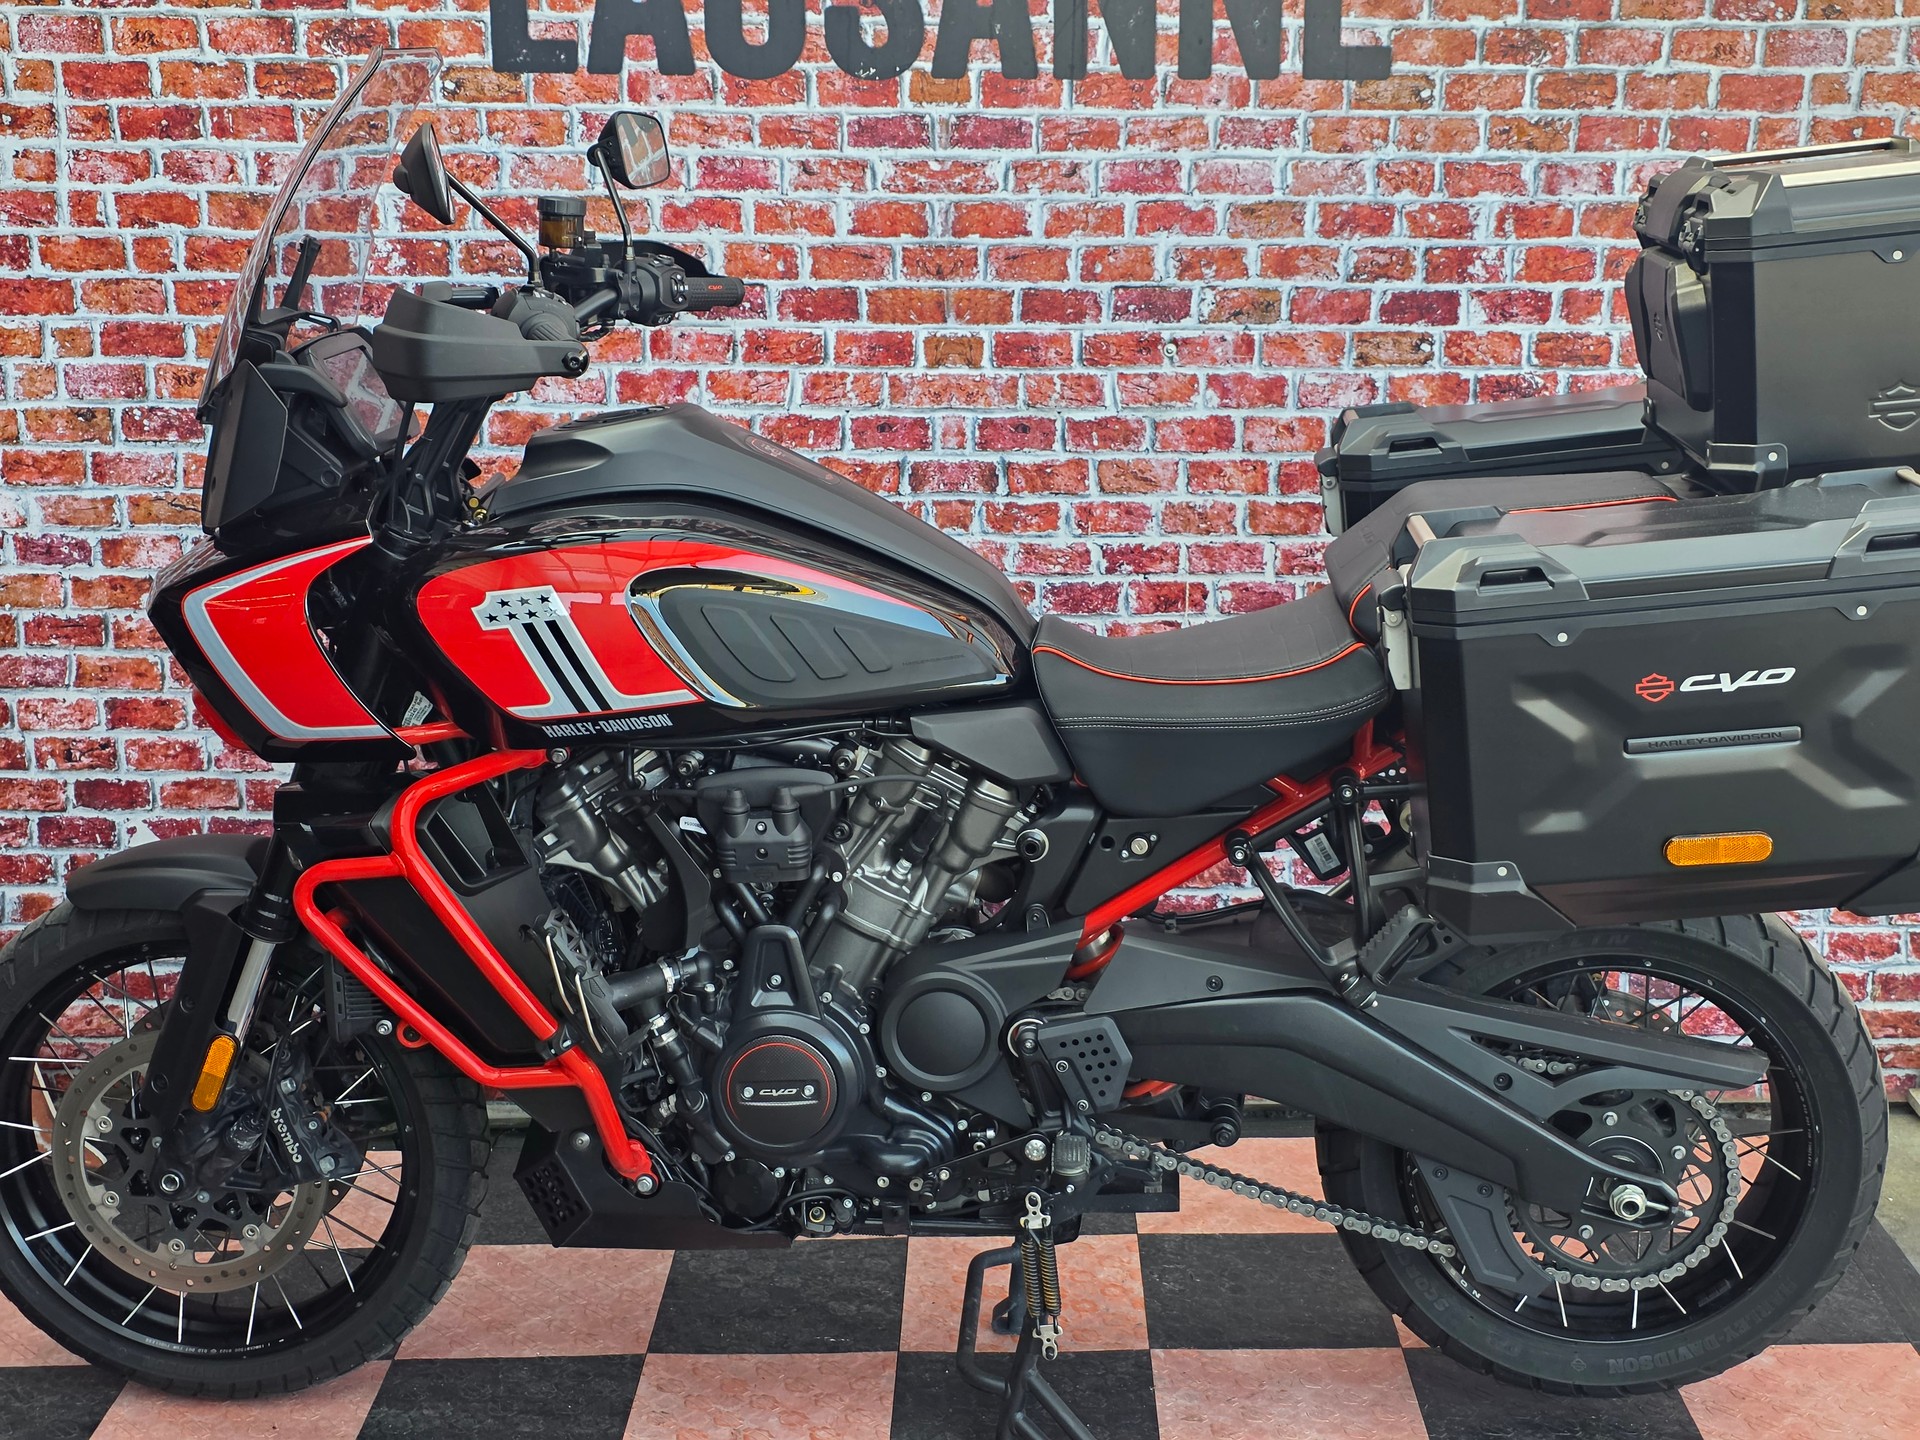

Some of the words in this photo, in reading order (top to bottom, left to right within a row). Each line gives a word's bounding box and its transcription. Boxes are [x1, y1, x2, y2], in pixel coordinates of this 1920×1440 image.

[1680, 667, 1796, 692] CVO
[542, 714, 673, 738] HARLEY-DAVIDSON
[1648, 731, 1782, 749] HARLEY-DAVIDSON
[759, 1088, 798, 1097] CVO
[271, 1107, 302, 1163] brembo
